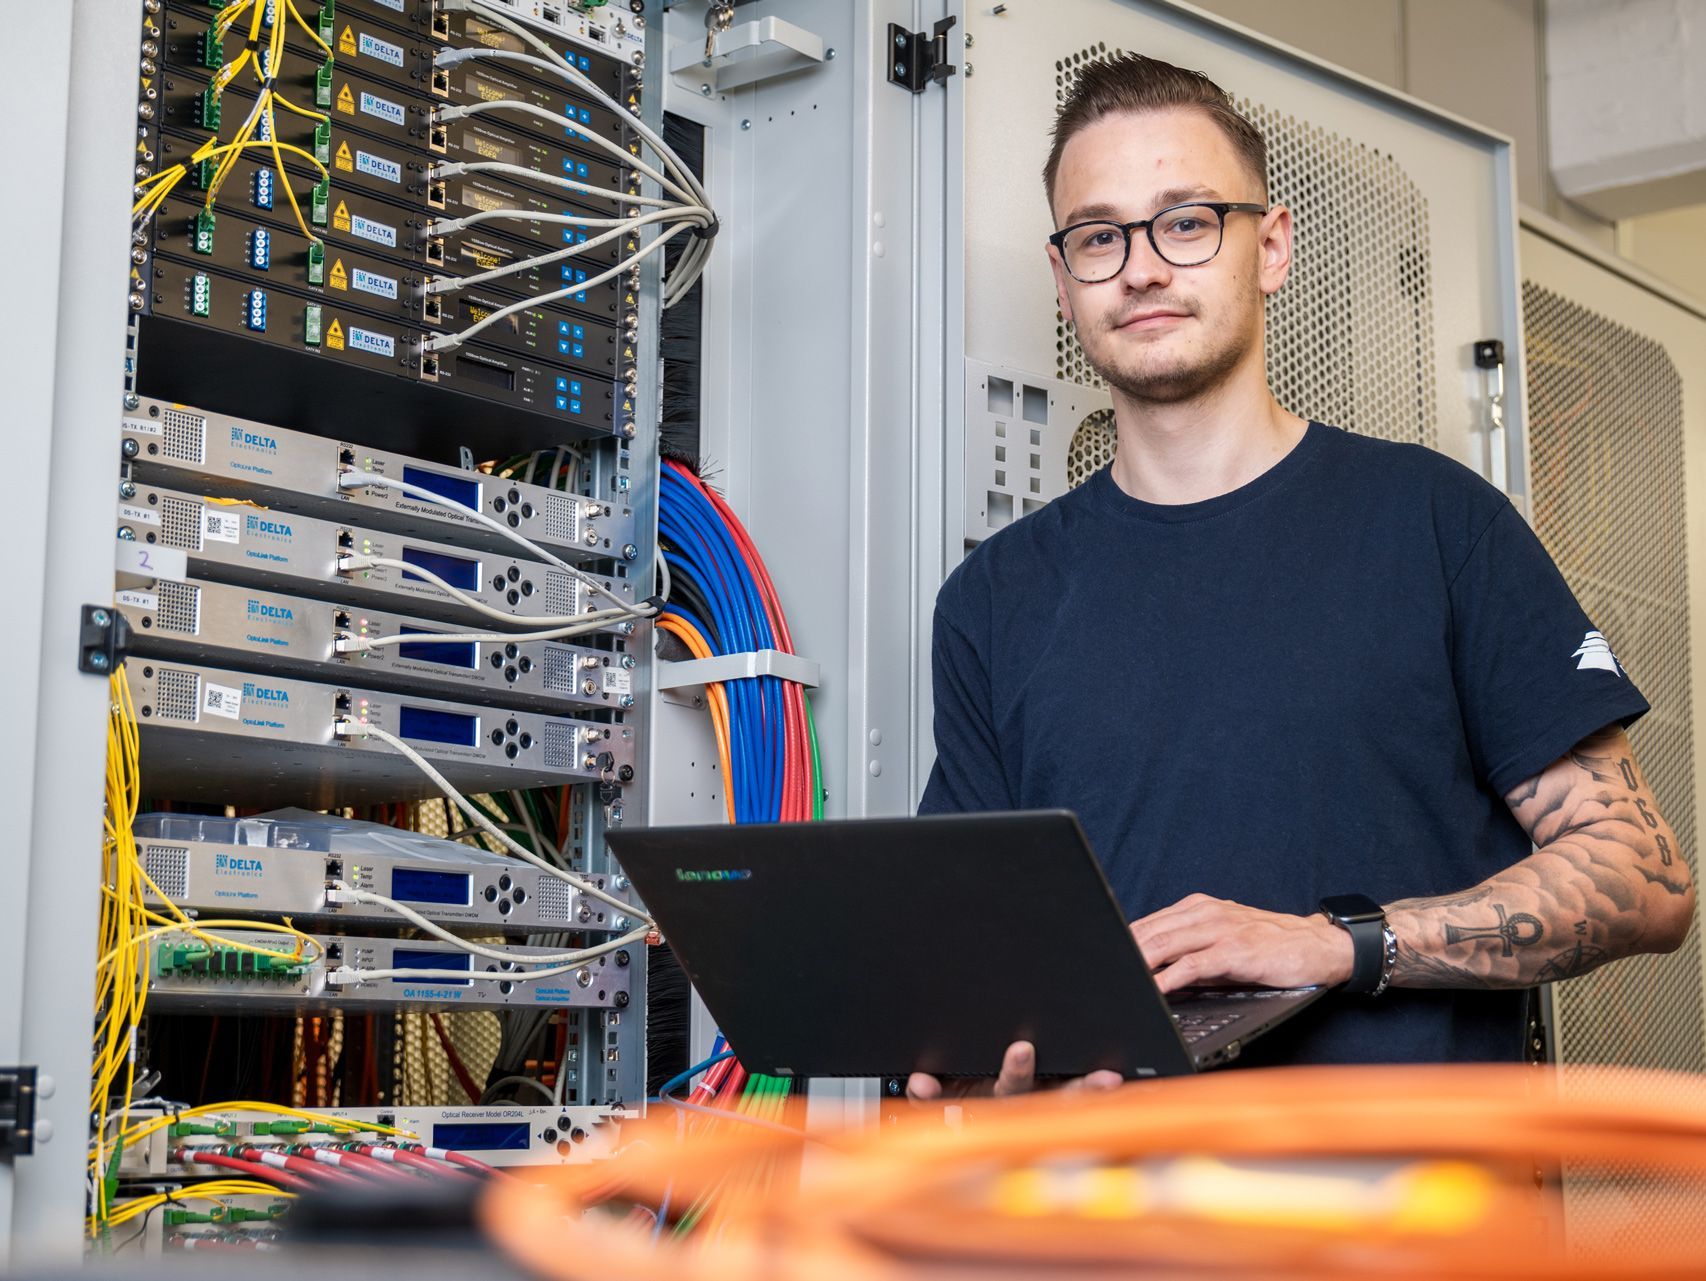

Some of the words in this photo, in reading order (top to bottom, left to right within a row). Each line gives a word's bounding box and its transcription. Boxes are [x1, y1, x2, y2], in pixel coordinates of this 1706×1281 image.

[374, 44, 400, 59] DELTA
[376, 102, 401, 116] DELTA
[371, 160, 397, 174] DELTA
[366, 225, 392, 239] DELTA
[368, 277, 394, 291] DELTA
[364, 336, 390, 348] DELTA
[244, 434, 276, 449] DELTA
[252, 466, 272, 475] Platform
[371, 491, 388, 499] Power2
[124, 509, 141, 518] DS-TX
[396, 502, 420, 512] Externally
[421, 506, 446, 517] Modulated
[260, 522, 292, 536] DELTA
[138, 550, 154, 570] 2
[269, 553, 289, 563] Platform
[395, 584, 414, 592] Externally
[416, 587, 436, 595] Modulated
[122, 595, 140, 603] DS-TX
[261, 605, 293, 620] DELTA
[270, 637, 289, 646] Platform
[392, 662, 412, 672] Externally
[413, 665, 433, 673] Modulated
[257, 688, 289, 702] DELTA
[266, 720, 285, 729] Platform
[230, 859, 262, 871] DELTA
[403, 989, 415, 997] OA
